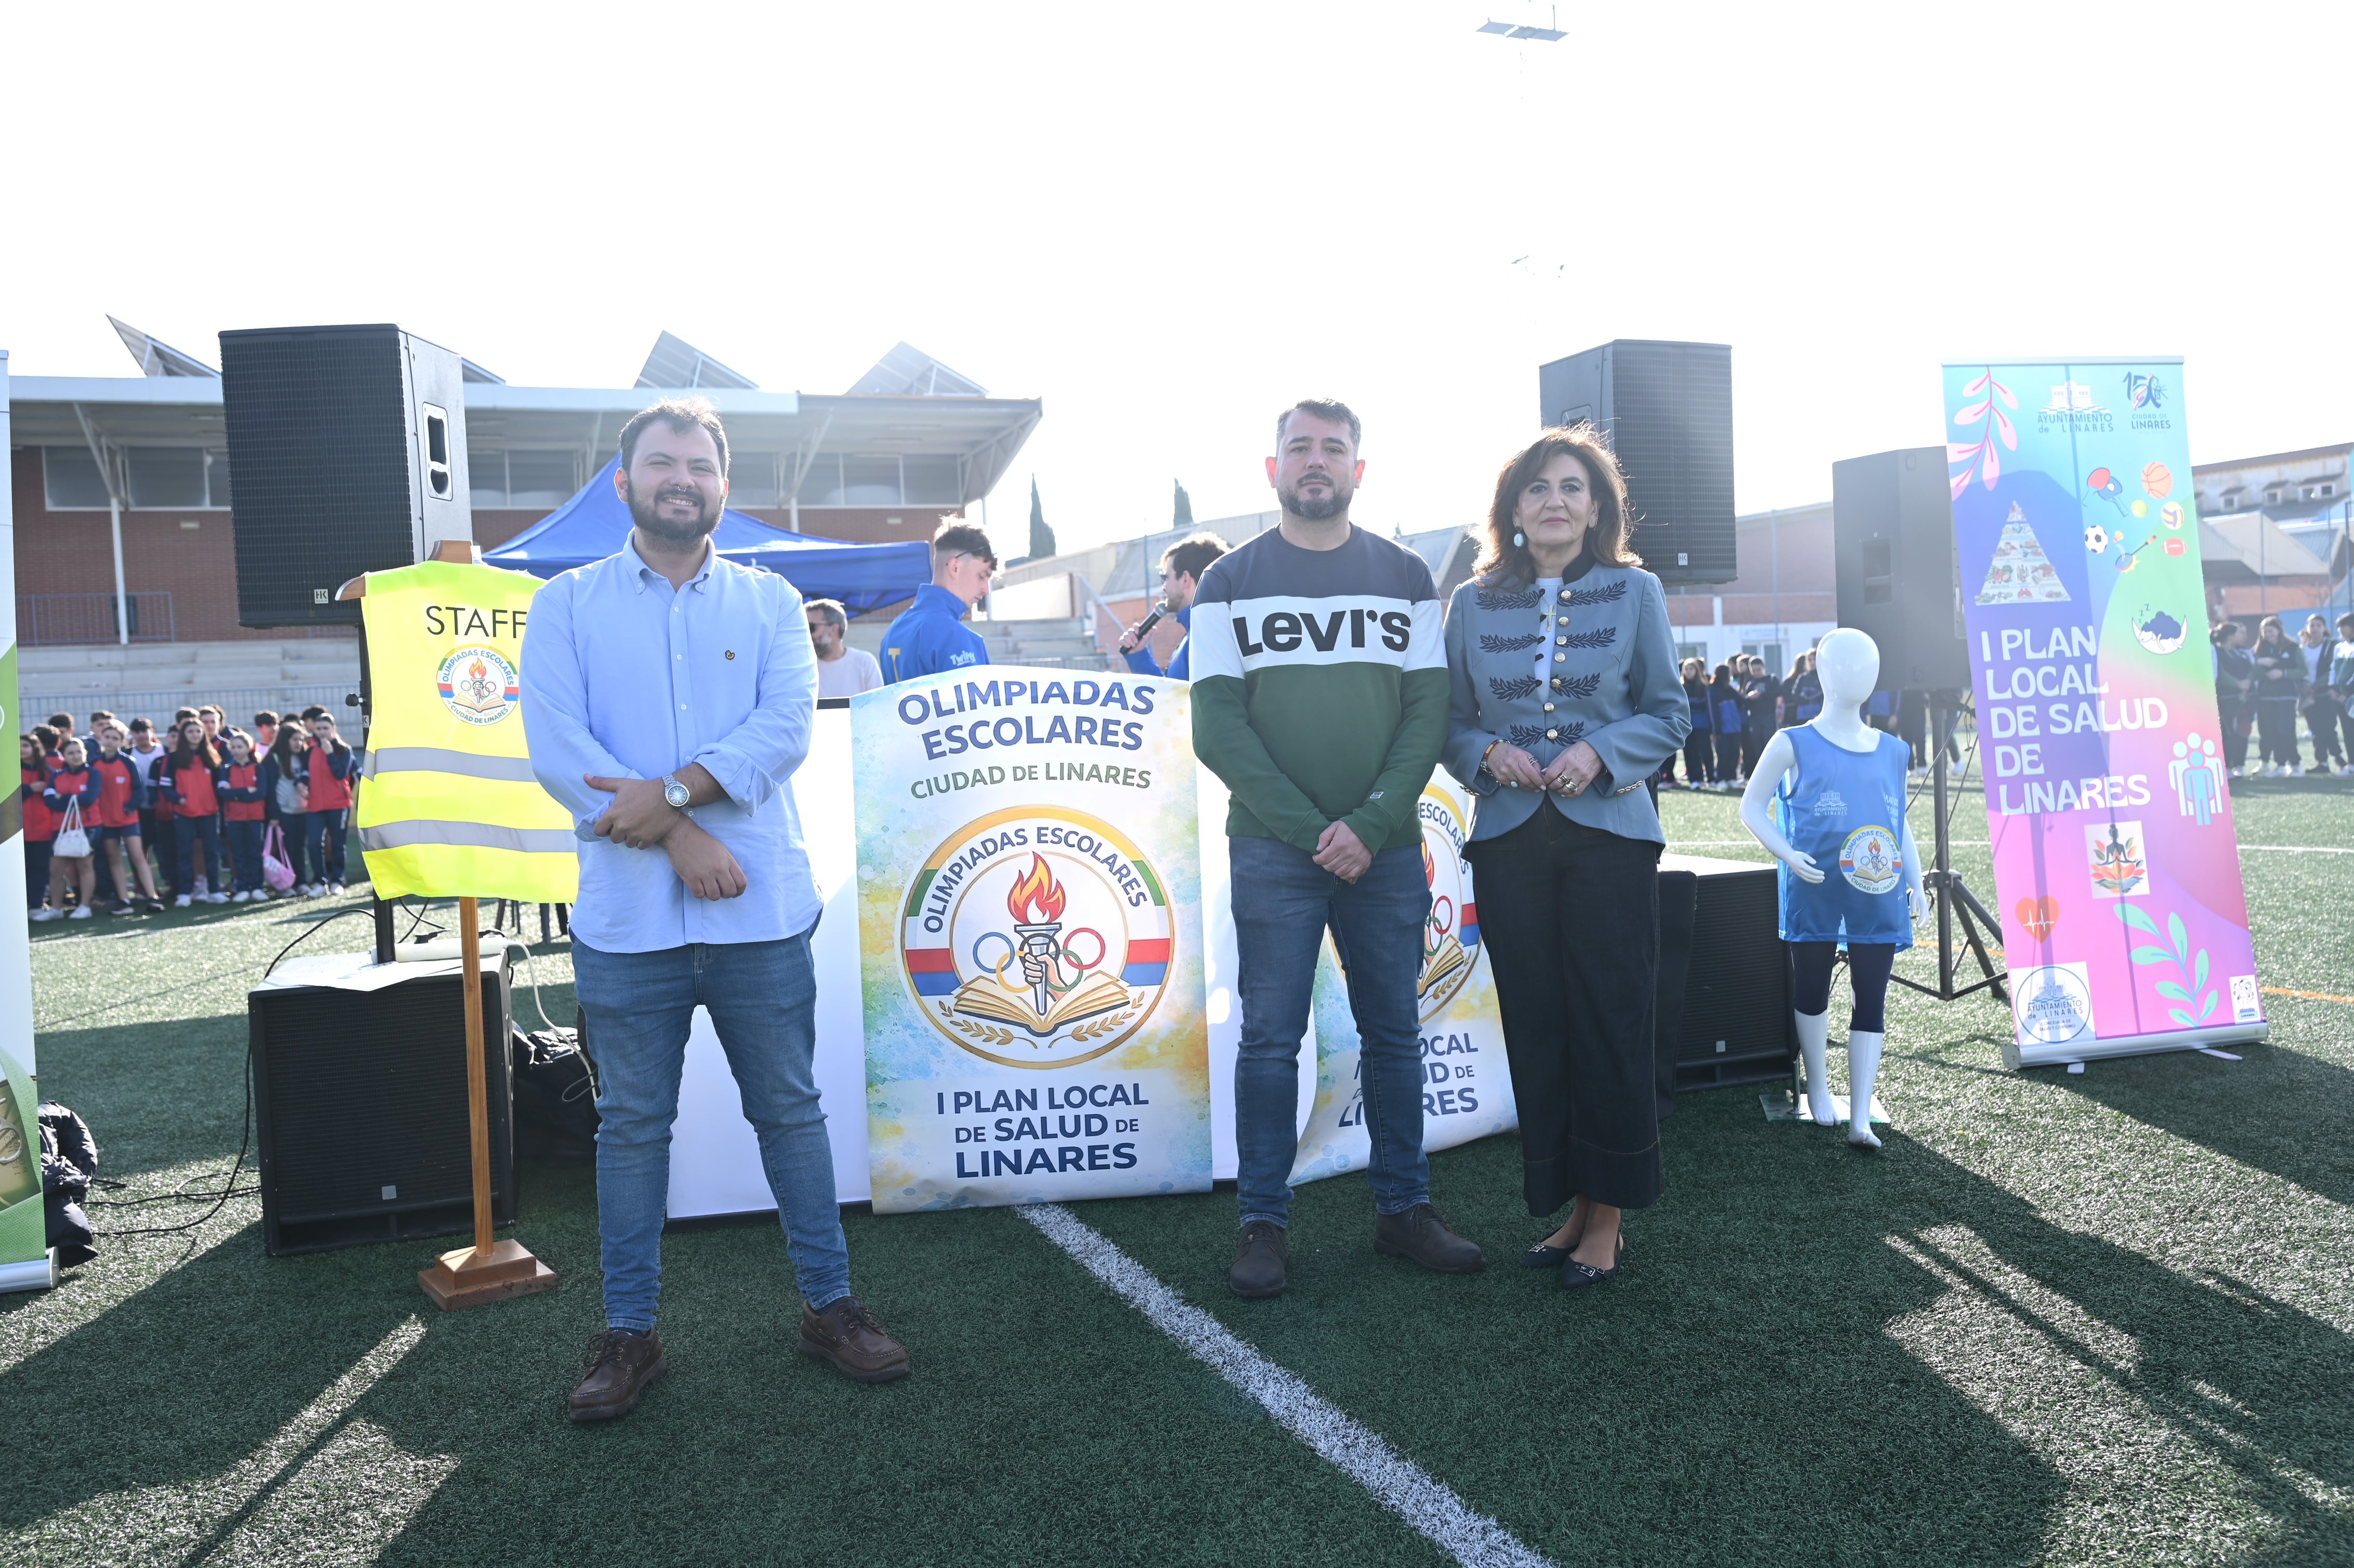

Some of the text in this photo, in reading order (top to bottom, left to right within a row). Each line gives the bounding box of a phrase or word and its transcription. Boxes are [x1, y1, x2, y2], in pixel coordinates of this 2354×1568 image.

[2038, 413, 2112, 424] AYUNTAMIENTO
[2062, 423, 2113, 433] LINARES
[2131, 420, 2170, 429] LINARES
[316, 591, 326, 599] HK
[426, 606, 527, 638] STAFF
[1981, 625, 2097, 662] I PLAN
[443, 650, 514, 685] OLIMPIADAS ESCOLARES
[1985, 663, 2109, 700] LOCAL
[451, 705, 473, 722] CIUDAD
[484, 707, 508, 723] LINARES
[898, 681, 1155, 725] OLIMPIADAS
[1990, 697, 2168, 738] DE SALUD
[921, 715, 1144, 761] ESCOLARES
[1994, 743, 2045, 777] DE
[911, 762, 1151, 799] CIUDAD DE LINARES
[1999, 774, 2151, 816] LINARES
[1845, 830, 1898, 860] OLIMPIADAS ESCOLARES
[924, 827, 1147, 933] OLIMPIADAS ESCOLARES
[1851, 878, 1871, 891] CIUDAD
[2028, 999, 2082, 1012] AYUNTAMIENTO
[2045, 1007, 2083, 1017] LINARES
[1455, 1065, 1475, 1079] DE
[937, 1083, 1149, 1115] I PLAN LOCAL
[955, 1114, 1140, 1143] DE SALUD DE
[956, 1142, 1137, 1179] LINARES
